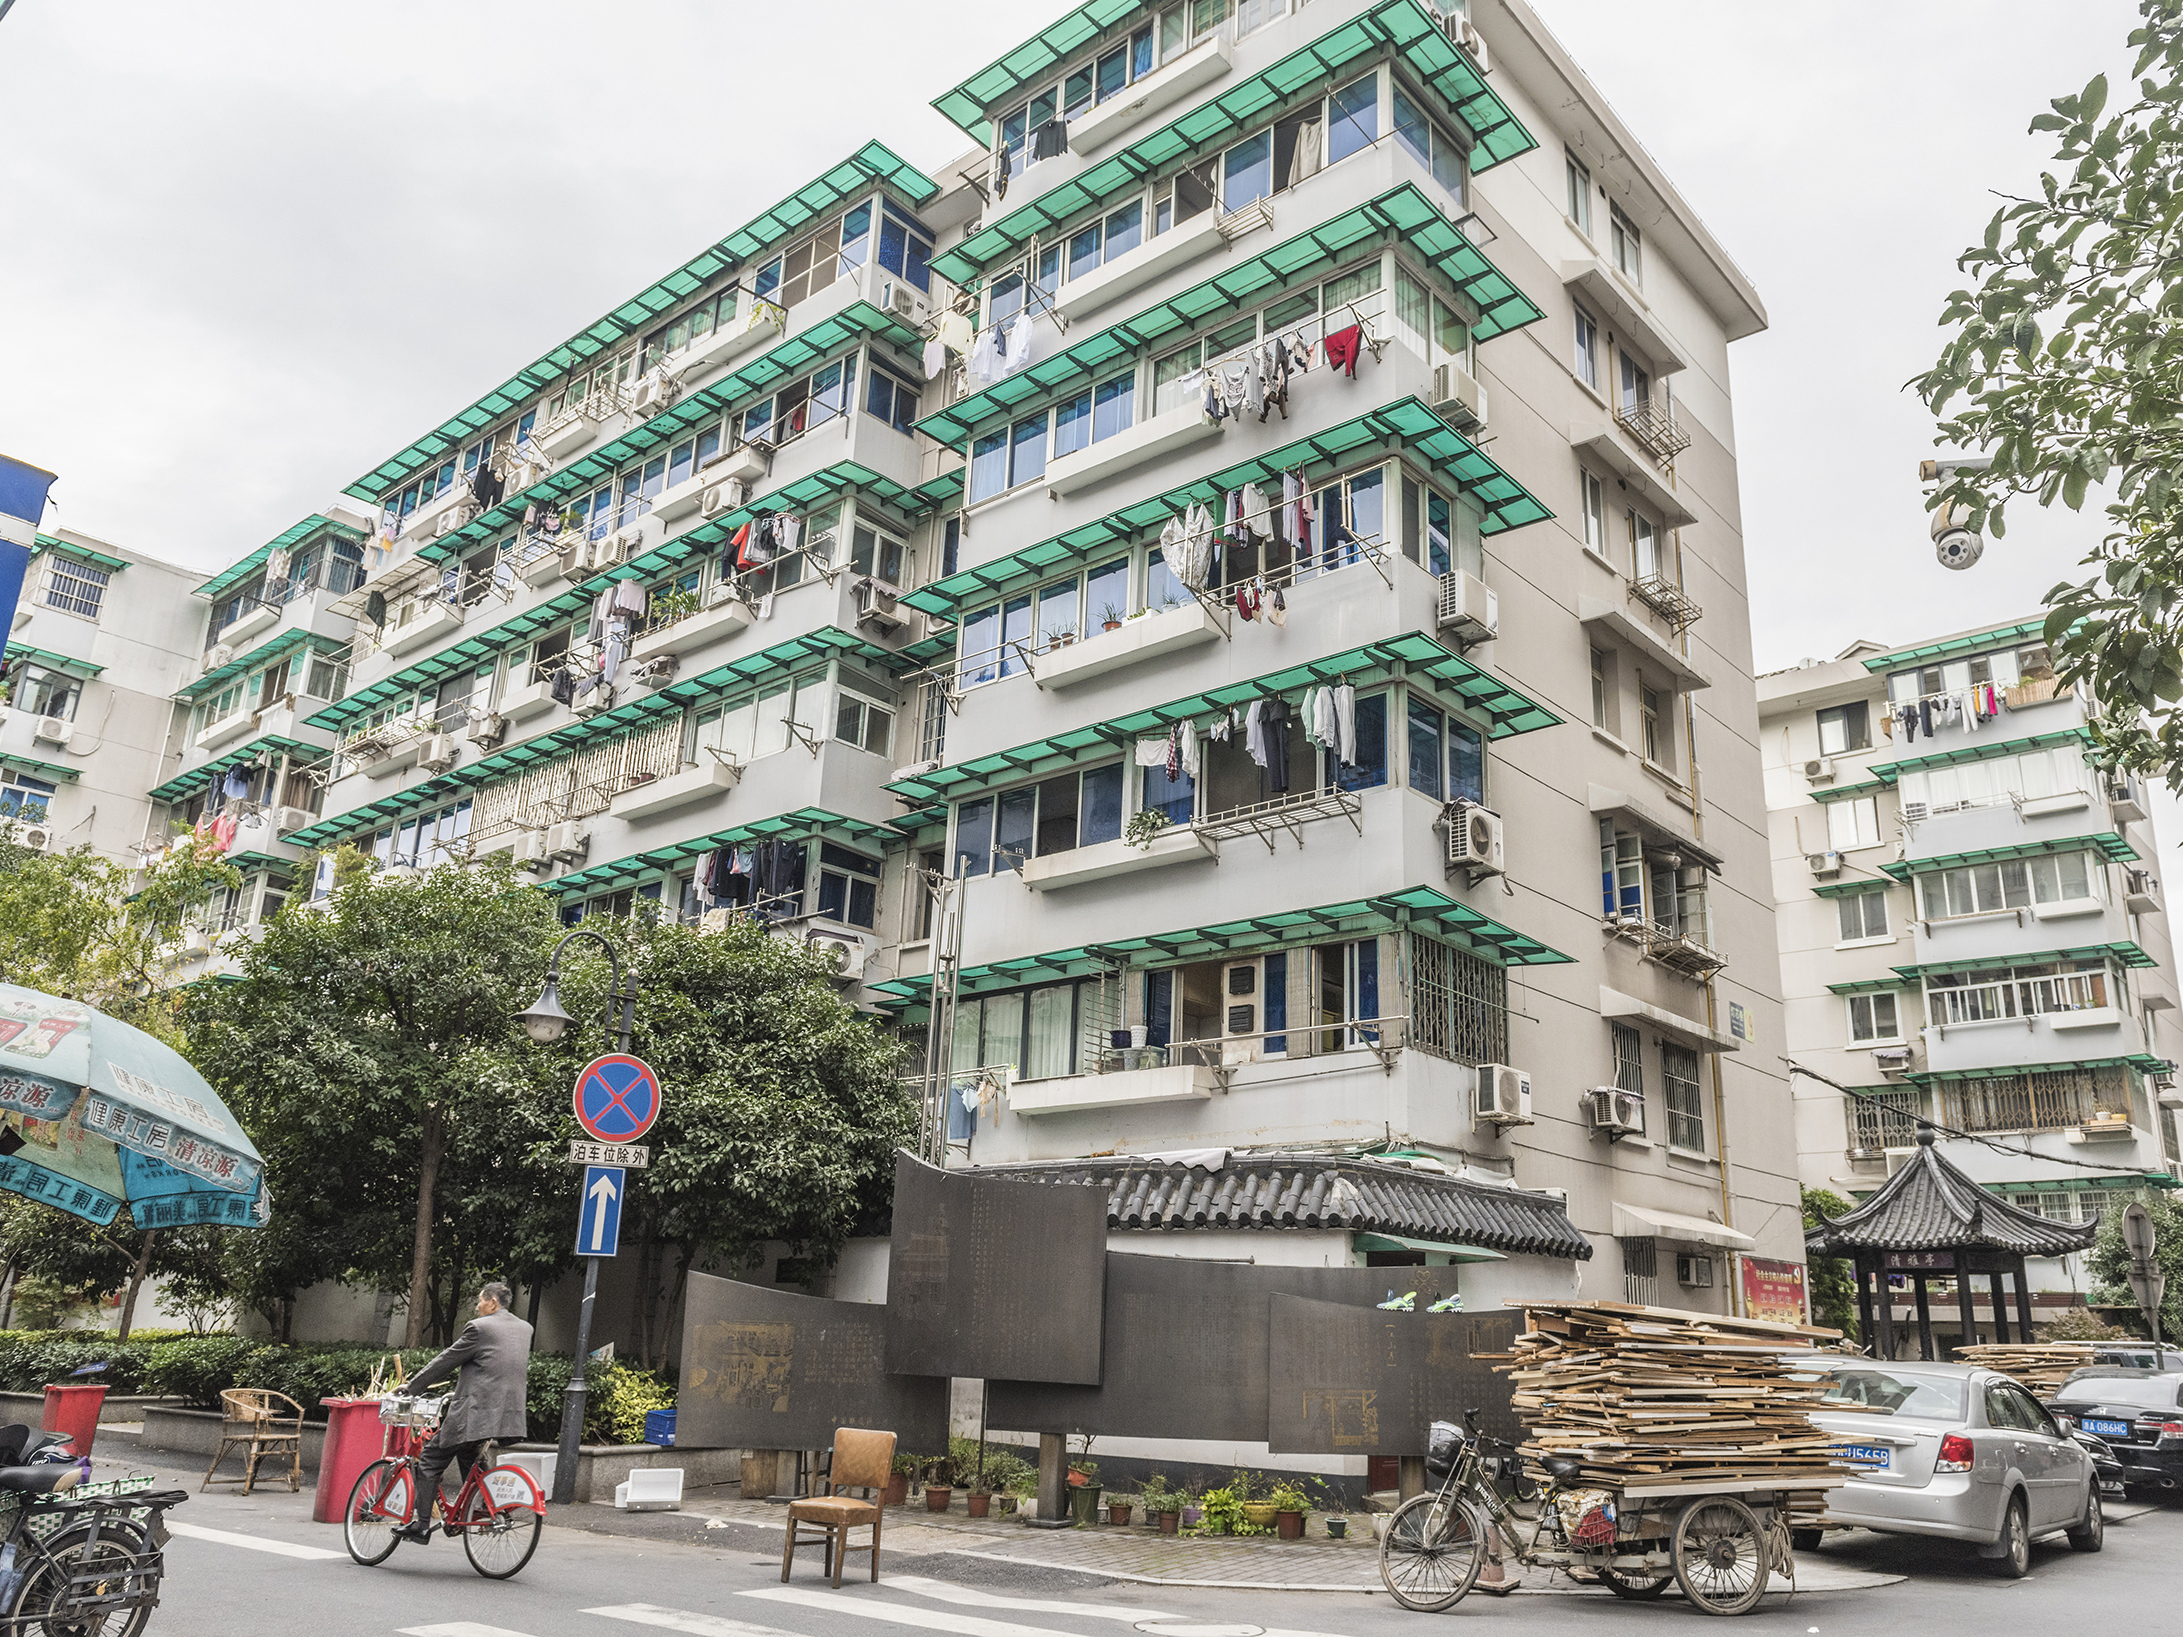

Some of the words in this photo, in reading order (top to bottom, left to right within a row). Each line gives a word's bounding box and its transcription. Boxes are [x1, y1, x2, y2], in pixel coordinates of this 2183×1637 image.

[110, 1064, 208, 1119] 健康工房
[90, 1100, 170, 1149] 健康工房
[175, 1137, 239, 1178] 清凉源
[573, 1144, 645, 1165] 泊车位除外
